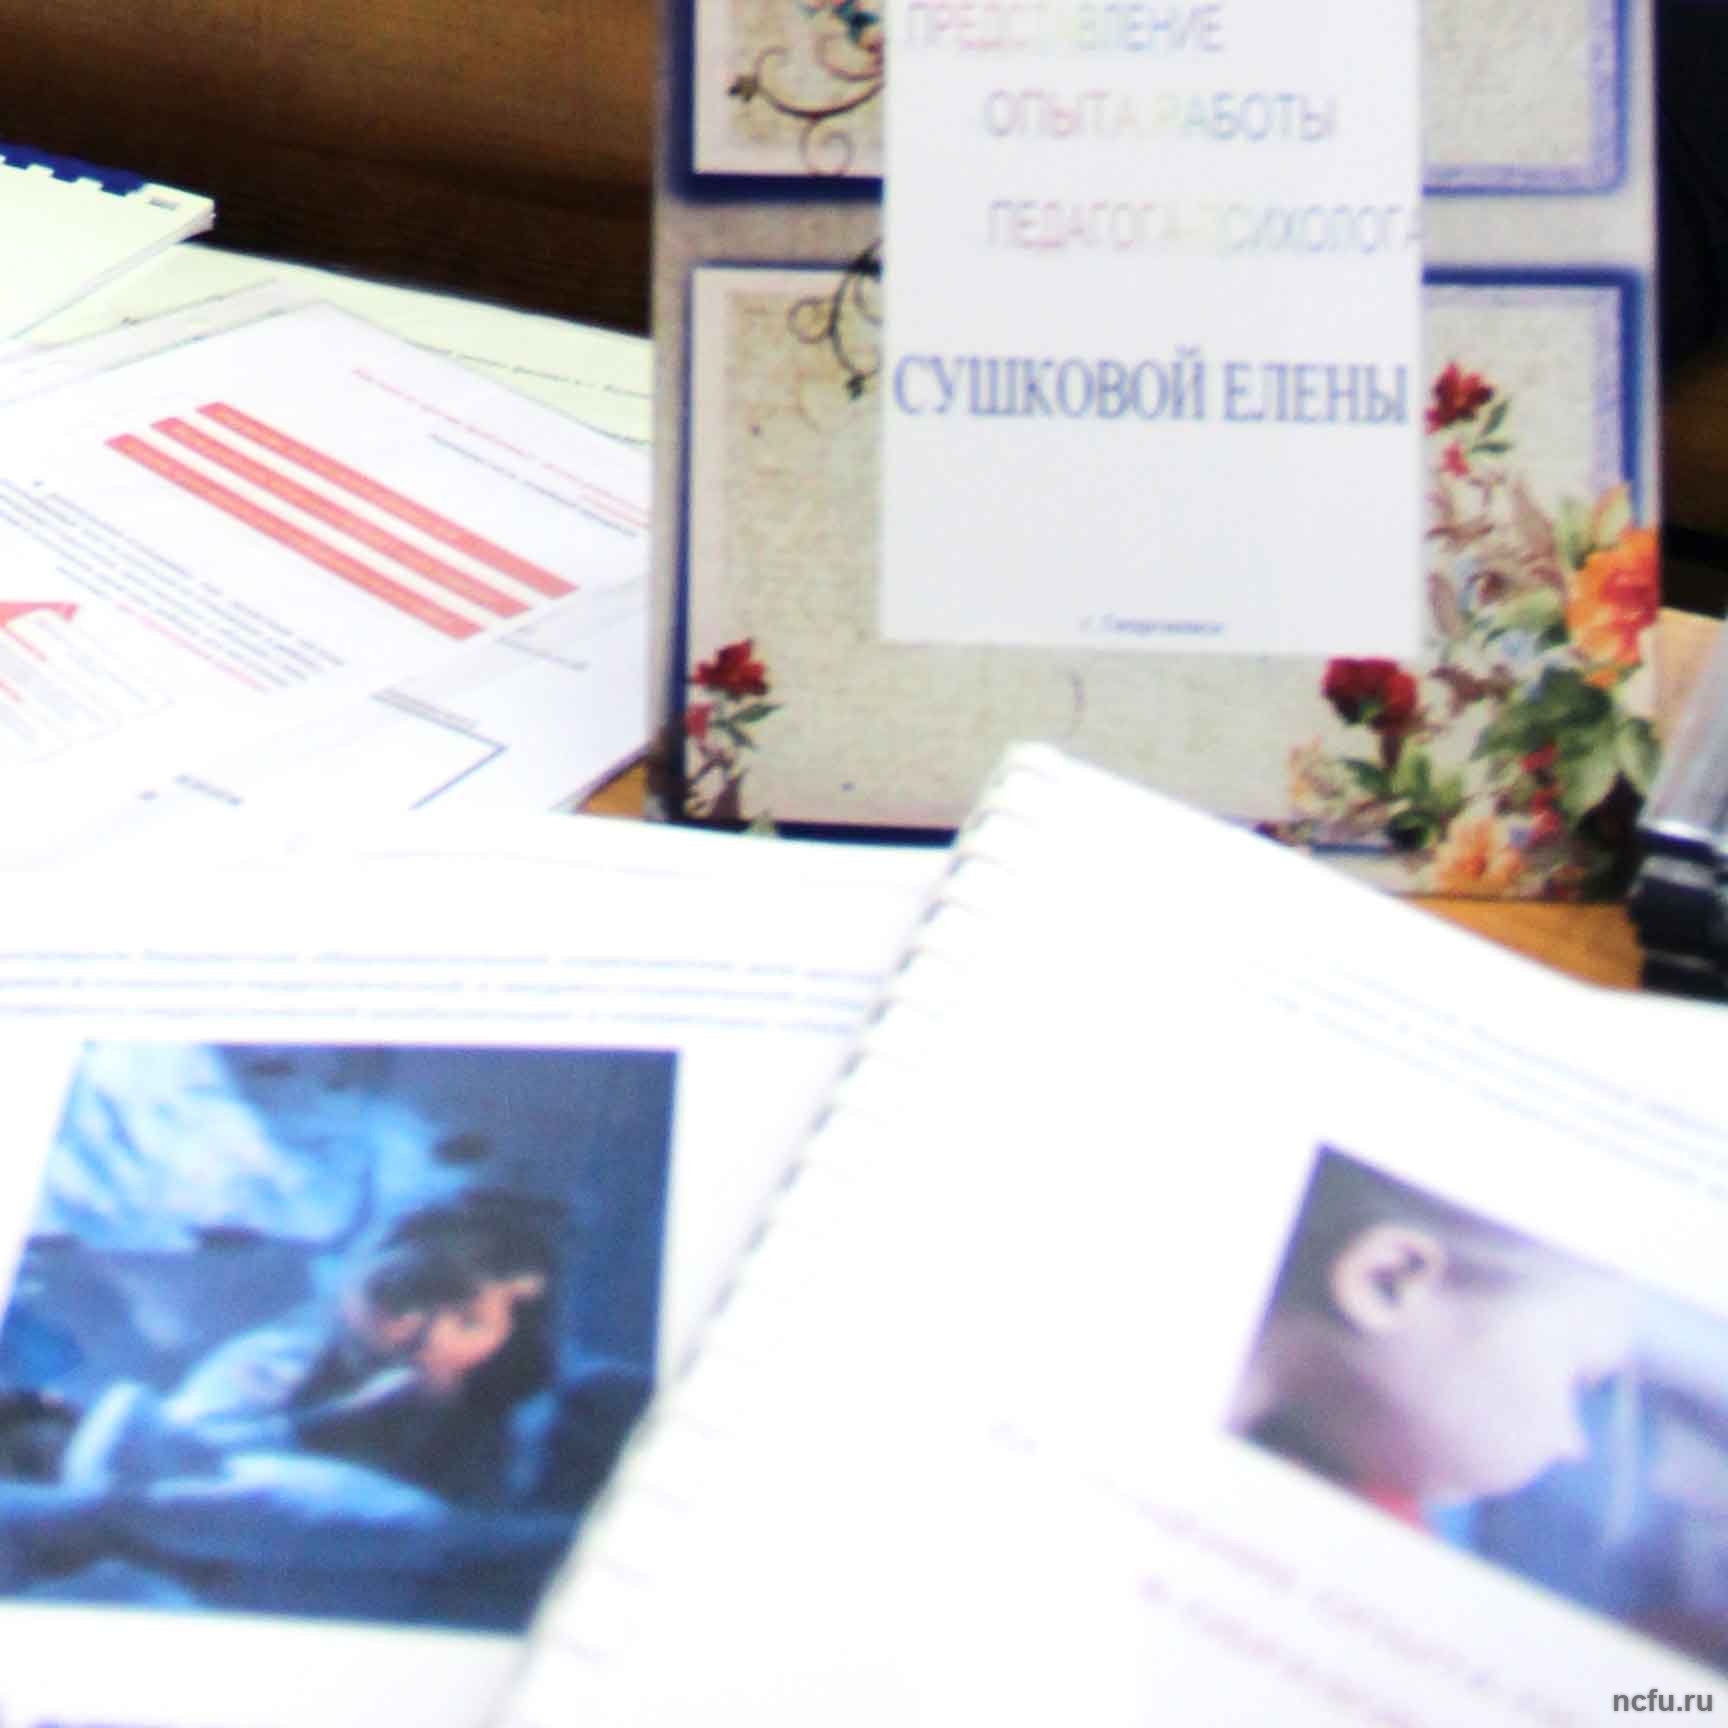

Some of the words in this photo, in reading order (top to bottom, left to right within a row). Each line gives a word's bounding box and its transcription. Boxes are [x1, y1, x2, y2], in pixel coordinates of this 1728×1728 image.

[983, 89, 1140, 140] ОПЫТА
[1152, 91, 1338, 143] РАБОТЫ
[892, 344, 1207, 422] СУШКОВОЙ
[1222, 361, 1411, 425] ЕЛЕНЫ
